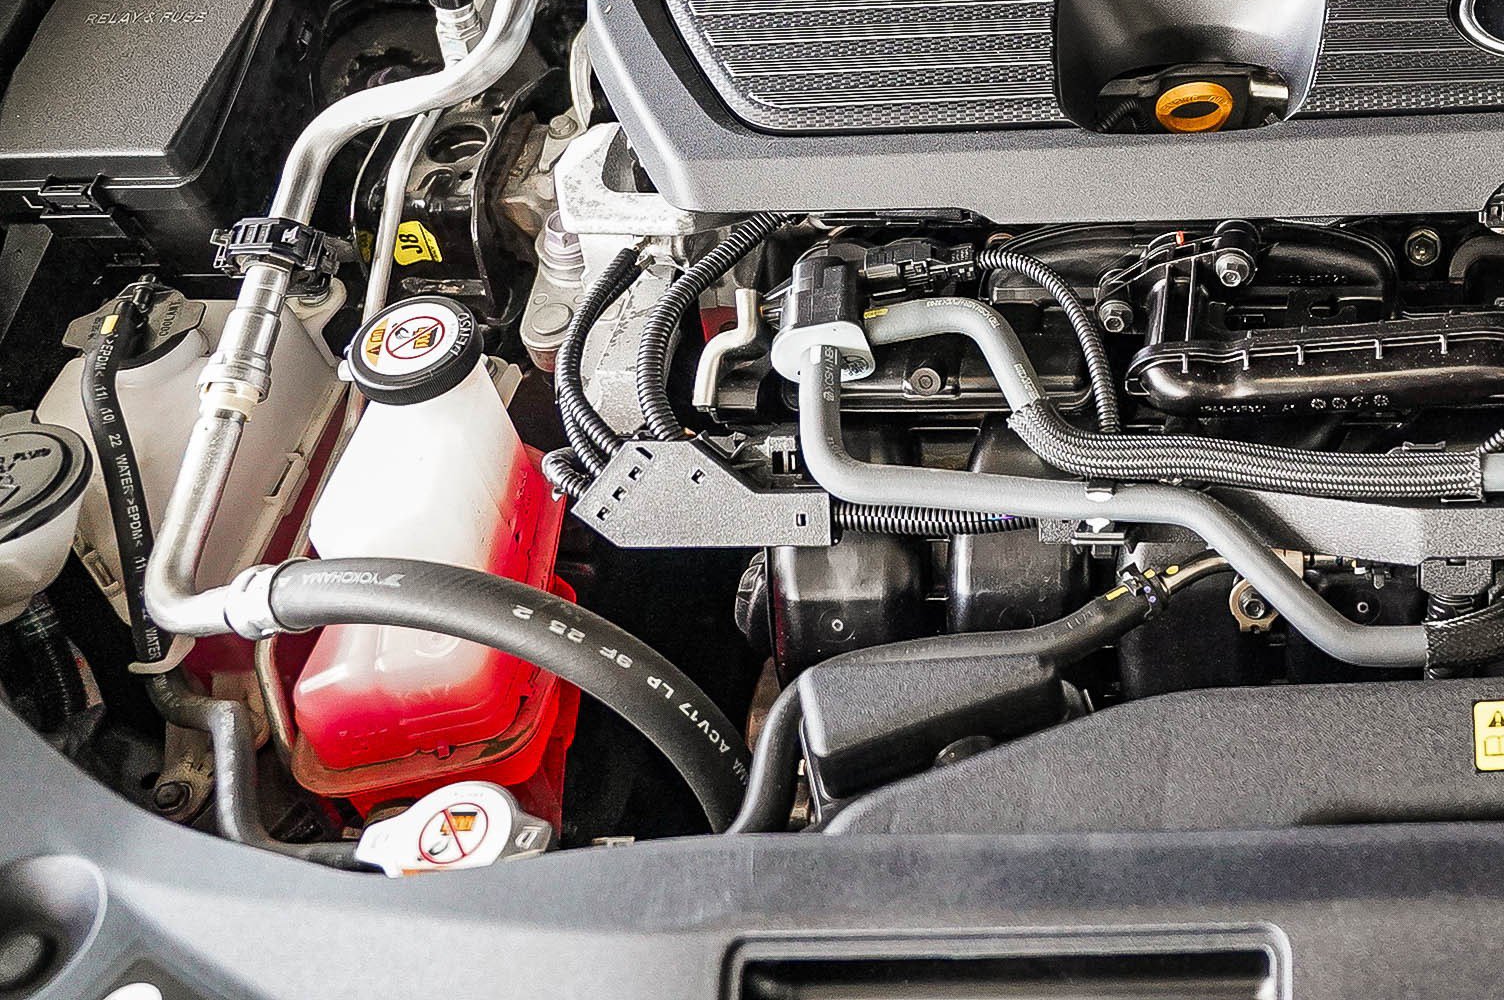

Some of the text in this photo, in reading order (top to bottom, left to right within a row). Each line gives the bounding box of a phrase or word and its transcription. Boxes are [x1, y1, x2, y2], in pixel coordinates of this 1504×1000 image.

[84, 10, 208, 25] RELAY & FUSE
[449, 312, 473, 357] DENSO
[108, 432, 123, 449] 22
[115, 453, 136, 495] WATER
[302, 571, 381, 586] YOKOHAMA
[512, 604, 534, 621] 2
[549, 619, 587, 644] 25
[646, 675, 675, 700] LP
[678, 701, 731, 754] ACV17
